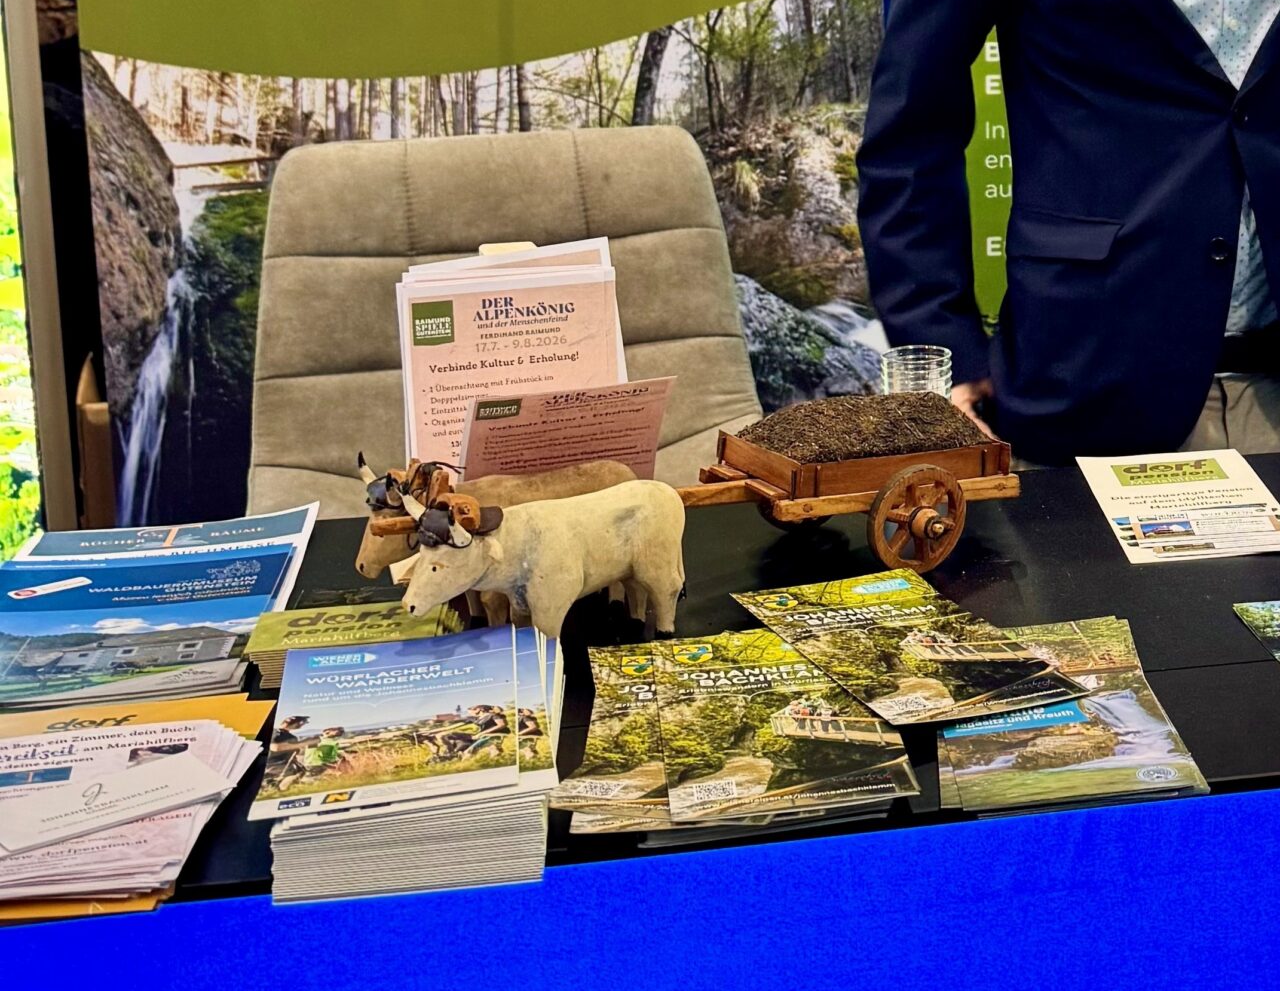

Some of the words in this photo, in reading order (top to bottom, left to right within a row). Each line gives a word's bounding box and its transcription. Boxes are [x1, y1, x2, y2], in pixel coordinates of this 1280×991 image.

[482, 296, 514, 310] DER
[473, 302, 576, 323] ALPENKÖNIG
[415, 316, 452, 325] RAIMUND
[477, 322, 494, 330] und
[495, 319, 509, 328] der
[509, 314, 569, 327] Menschenfeind
[480, 330, 524, 340] FERDINAND
[525, 326, 561, 336] RAIMUND
[512, 335, 568, 349] 9.8.2026
[429, 363, 478, 374] Verbinde
[480, 358, 516, 370] Kultur
[529, 351, 579, 365] Erholung!
[435, 381, 489, 393] Übernachtung
[1129, 469, 1215, 481] pension
[805, 604, 937, 626] BACHKLAMM
[318, 657, 362, 666] ALPEN
[306, 664, 441, 685] WÜRFLACHER
[335, 665, 475, 689] WANDERWELT
[47, 714, 137, 731] dorf
[1007, 714, 1031, 724] und
